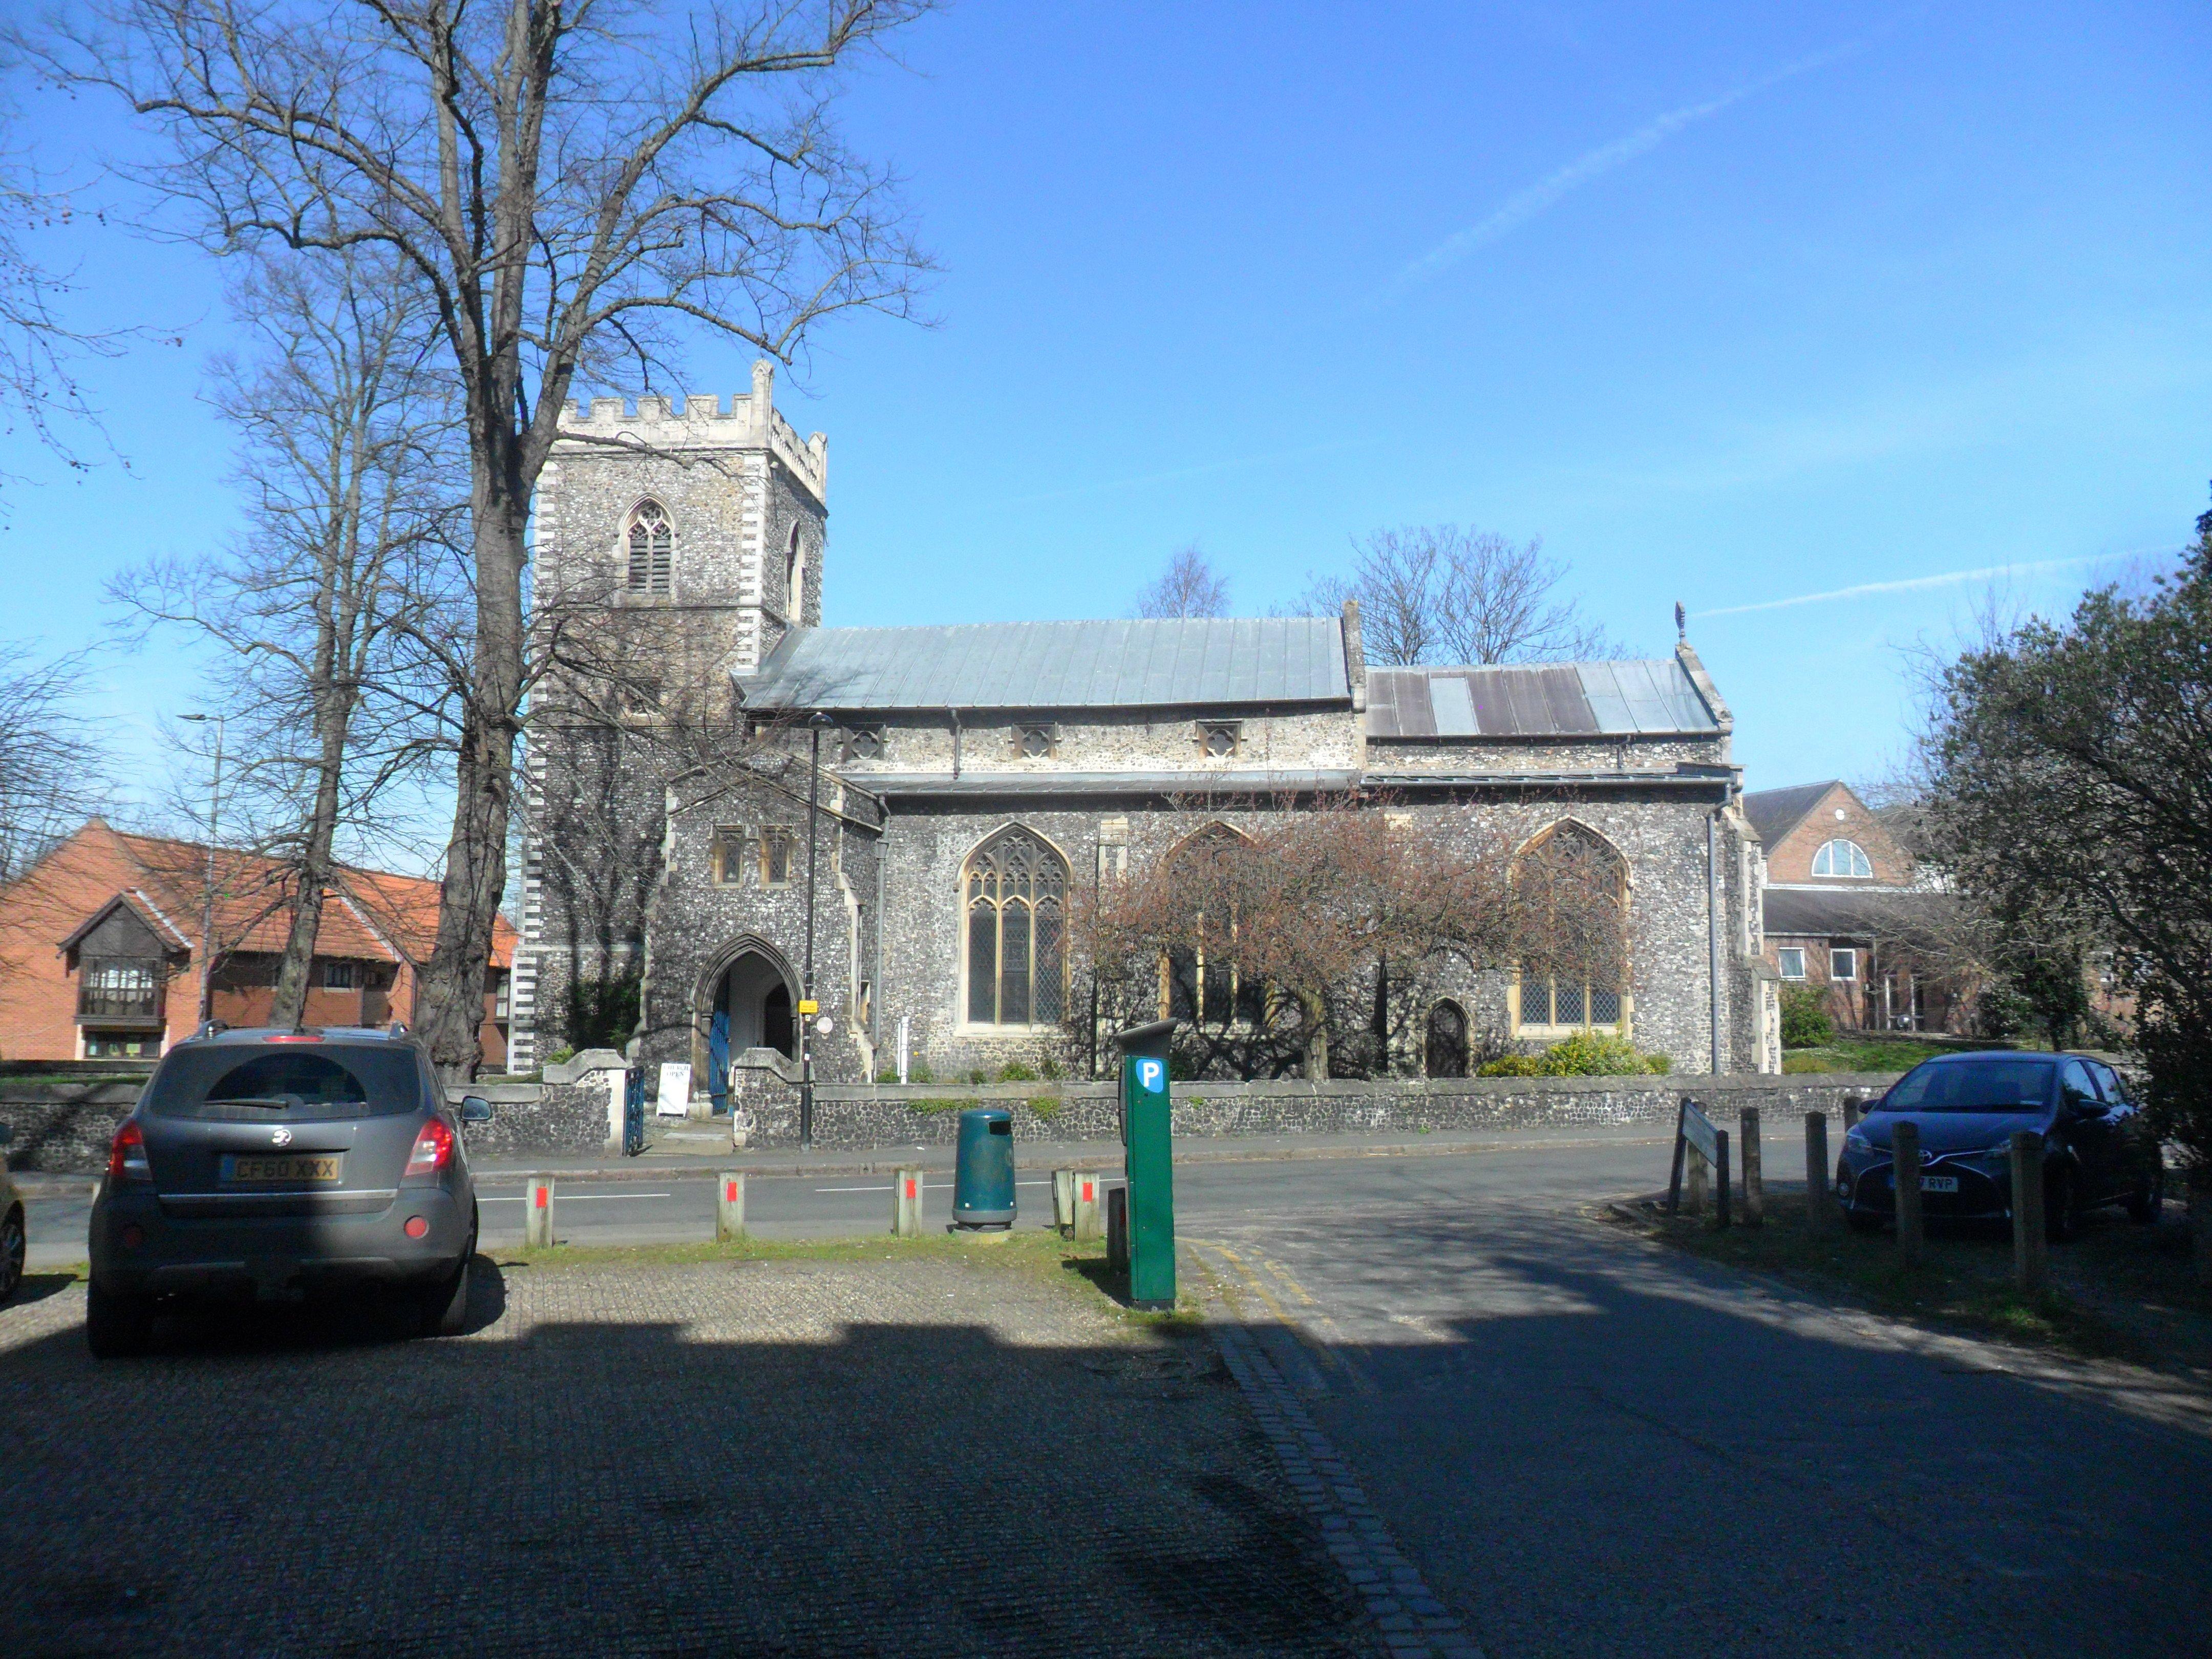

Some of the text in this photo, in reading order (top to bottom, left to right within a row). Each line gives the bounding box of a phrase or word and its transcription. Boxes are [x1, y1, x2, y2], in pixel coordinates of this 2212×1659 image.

[1143, 1062, 1159, 1088] P
[237, 1160, 334, 1177] CF60 XXX
